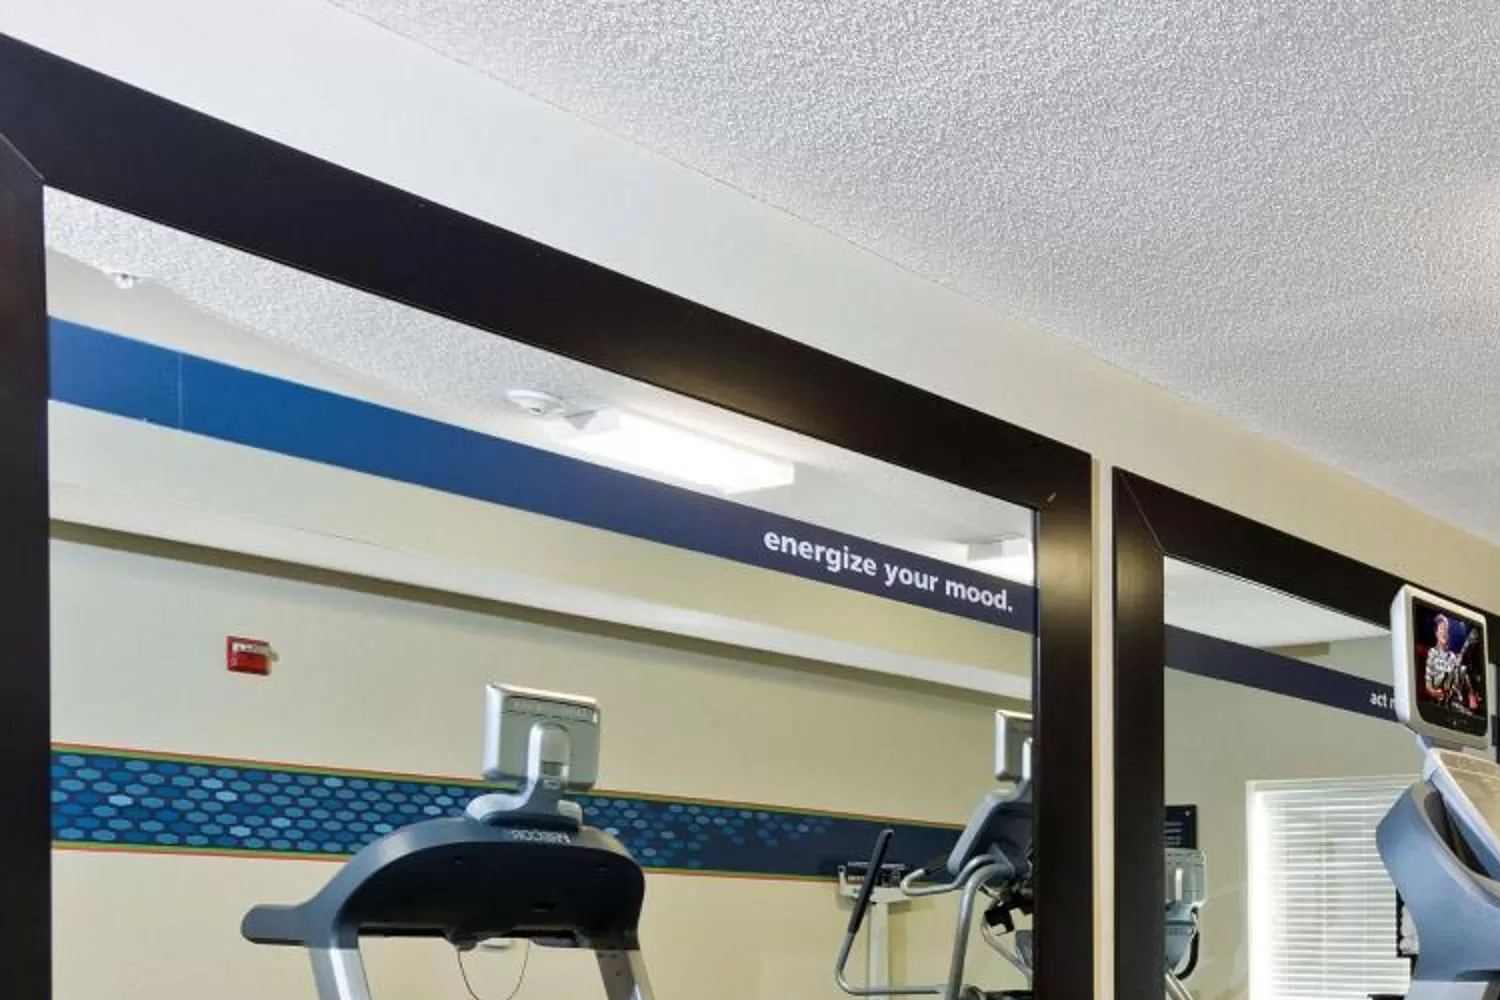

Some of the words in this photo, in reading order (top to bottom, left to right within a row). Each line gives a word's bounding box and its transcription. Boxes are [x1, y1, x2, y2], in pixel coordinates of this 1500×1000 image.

[763, 531, 877, 576] energize
[884, 563, 939, 592] your
[945, 578, 1013, 612] mood.
